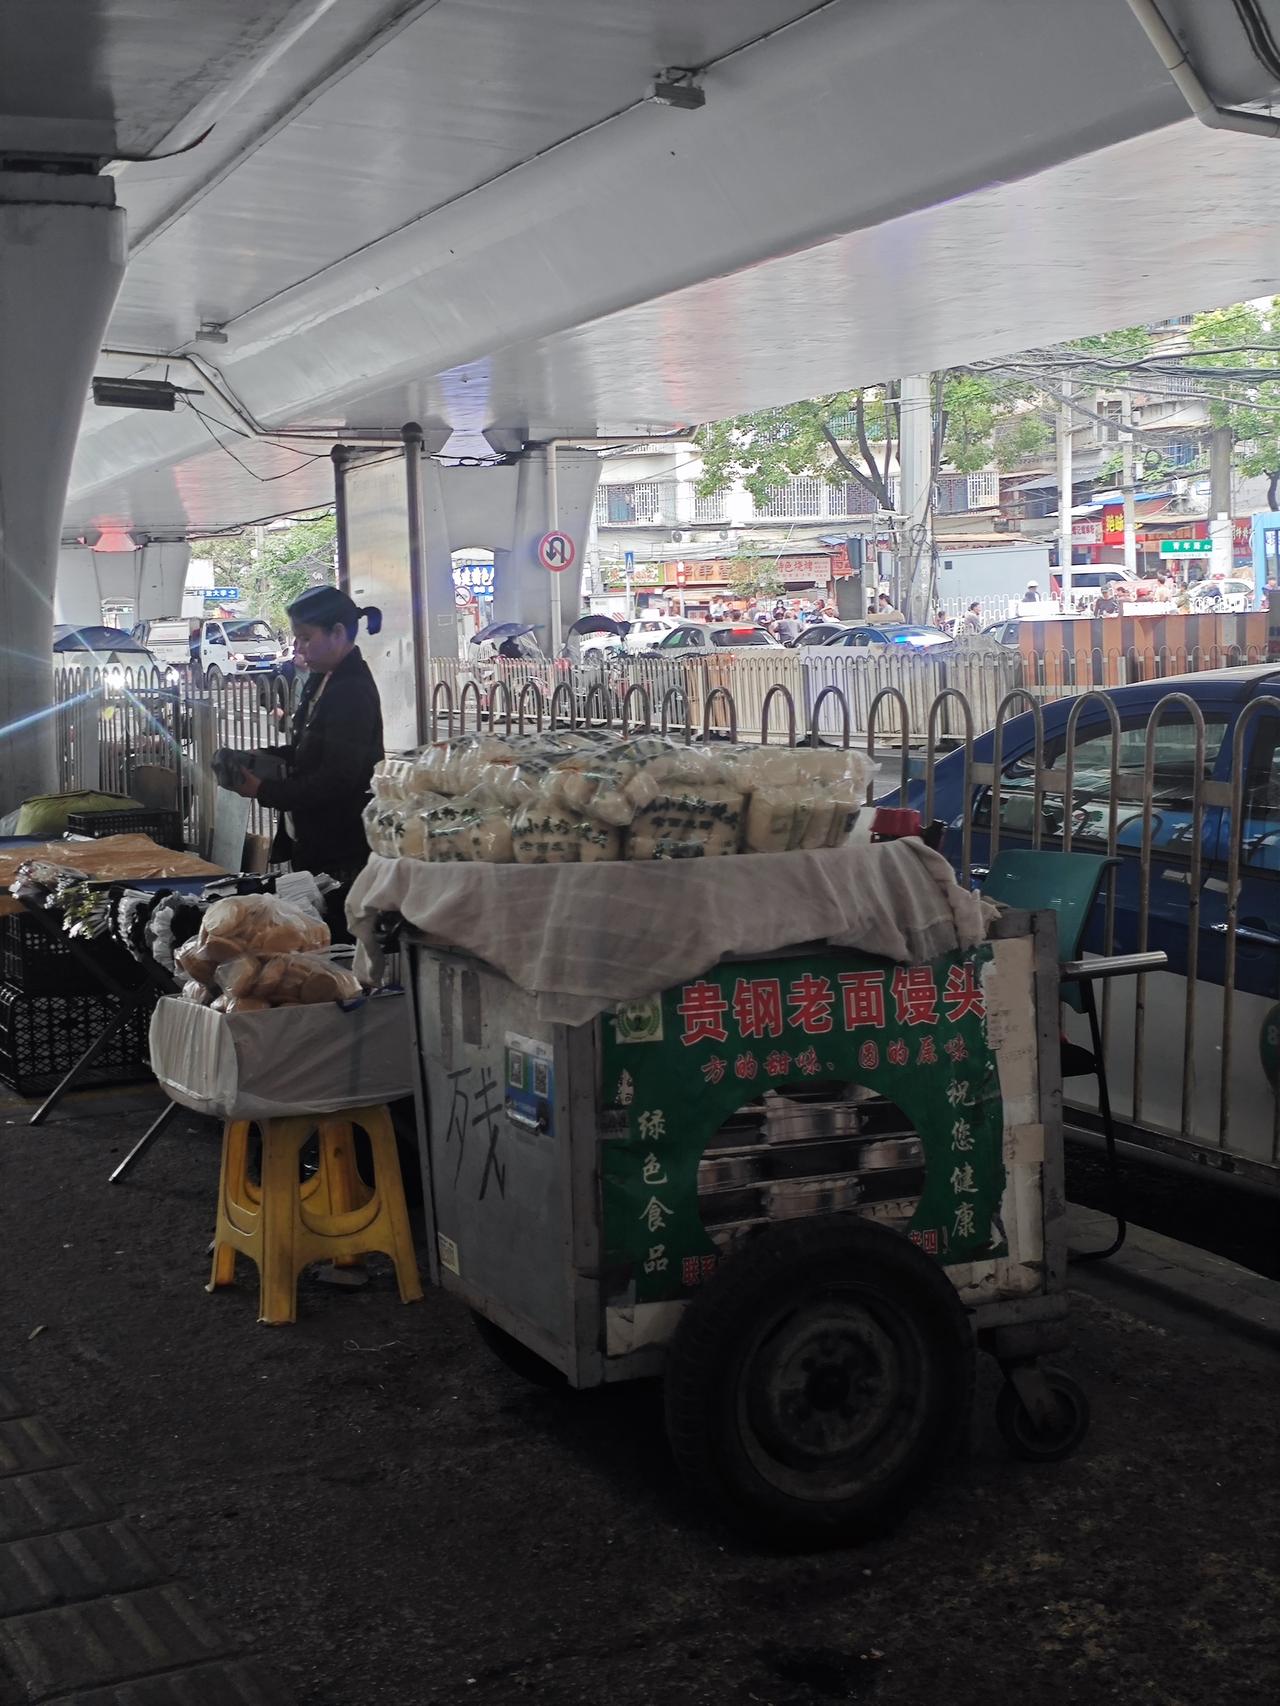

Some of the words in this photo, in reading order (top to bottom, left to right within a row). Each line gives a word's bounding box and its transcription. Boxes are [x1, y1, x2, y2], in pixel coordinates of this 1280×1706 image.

[676, 962, 986, 1046] 贵钢老面馒头
[637, 1109, 675, 1275] 绿色食品
[945, 1078, 980, 1240] 祝您健康
